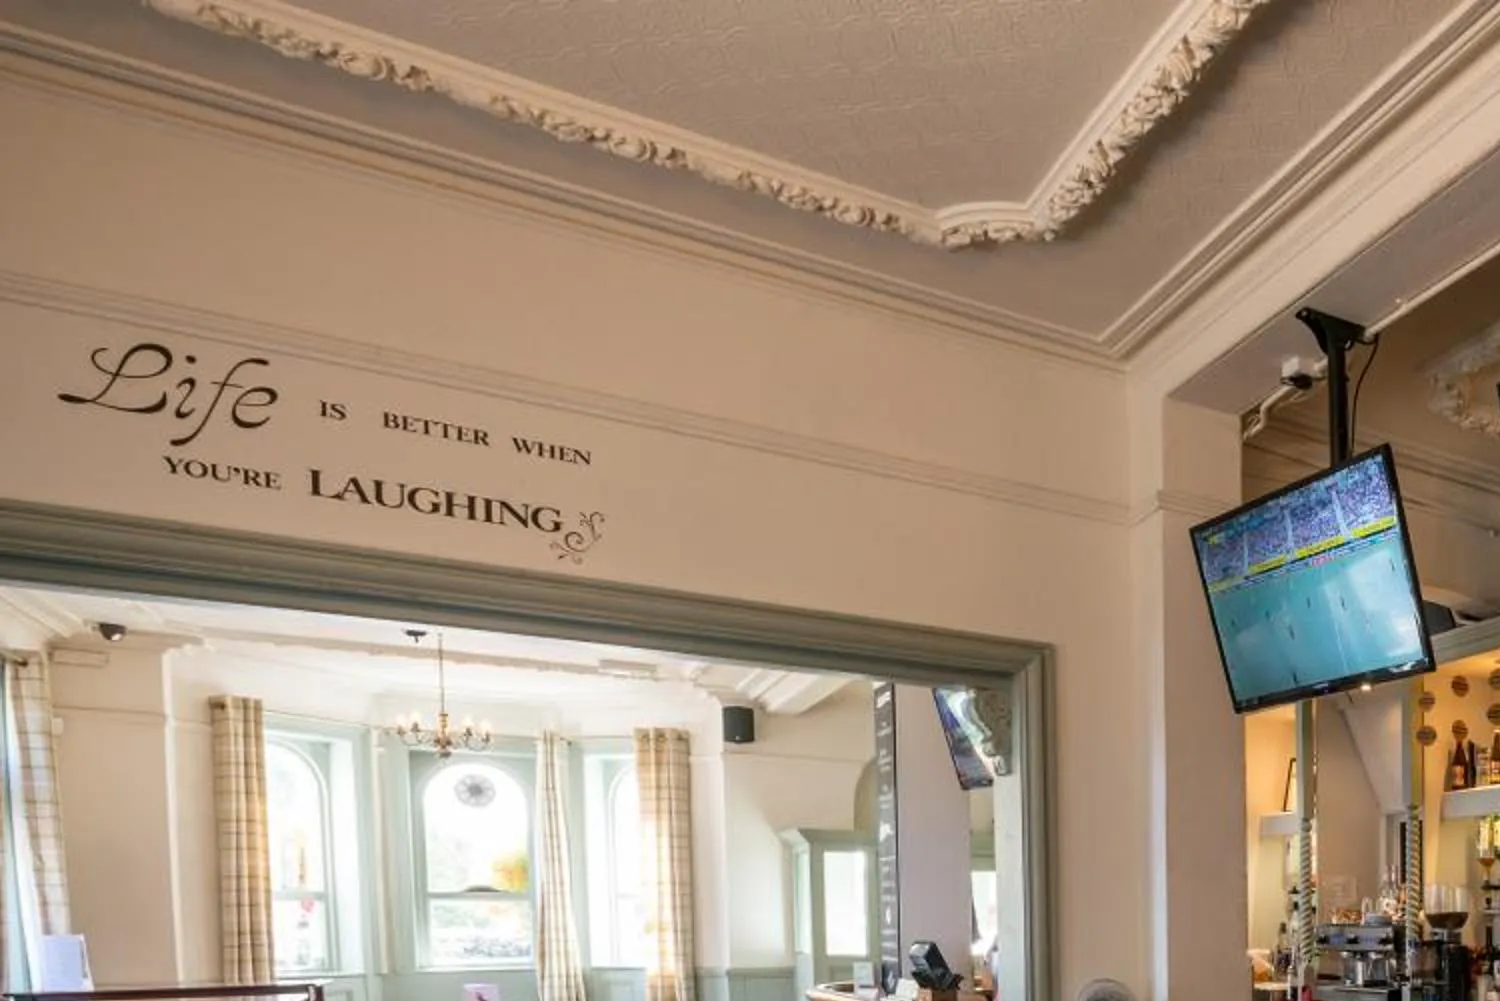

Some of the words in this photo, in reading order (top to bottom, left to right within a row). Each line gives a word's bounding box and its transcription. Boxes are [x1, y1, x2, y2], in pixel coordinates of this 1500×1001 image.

[57, 343, 279, 446] Life
[319, 400, 348, 422] IS
[382, 411, 490, 447] BETTER
[511, 437, 593, 466] WHEN
[162, 455, 282, 491] YOU'RE
[308, 468, 563, 533] LAUGHING
